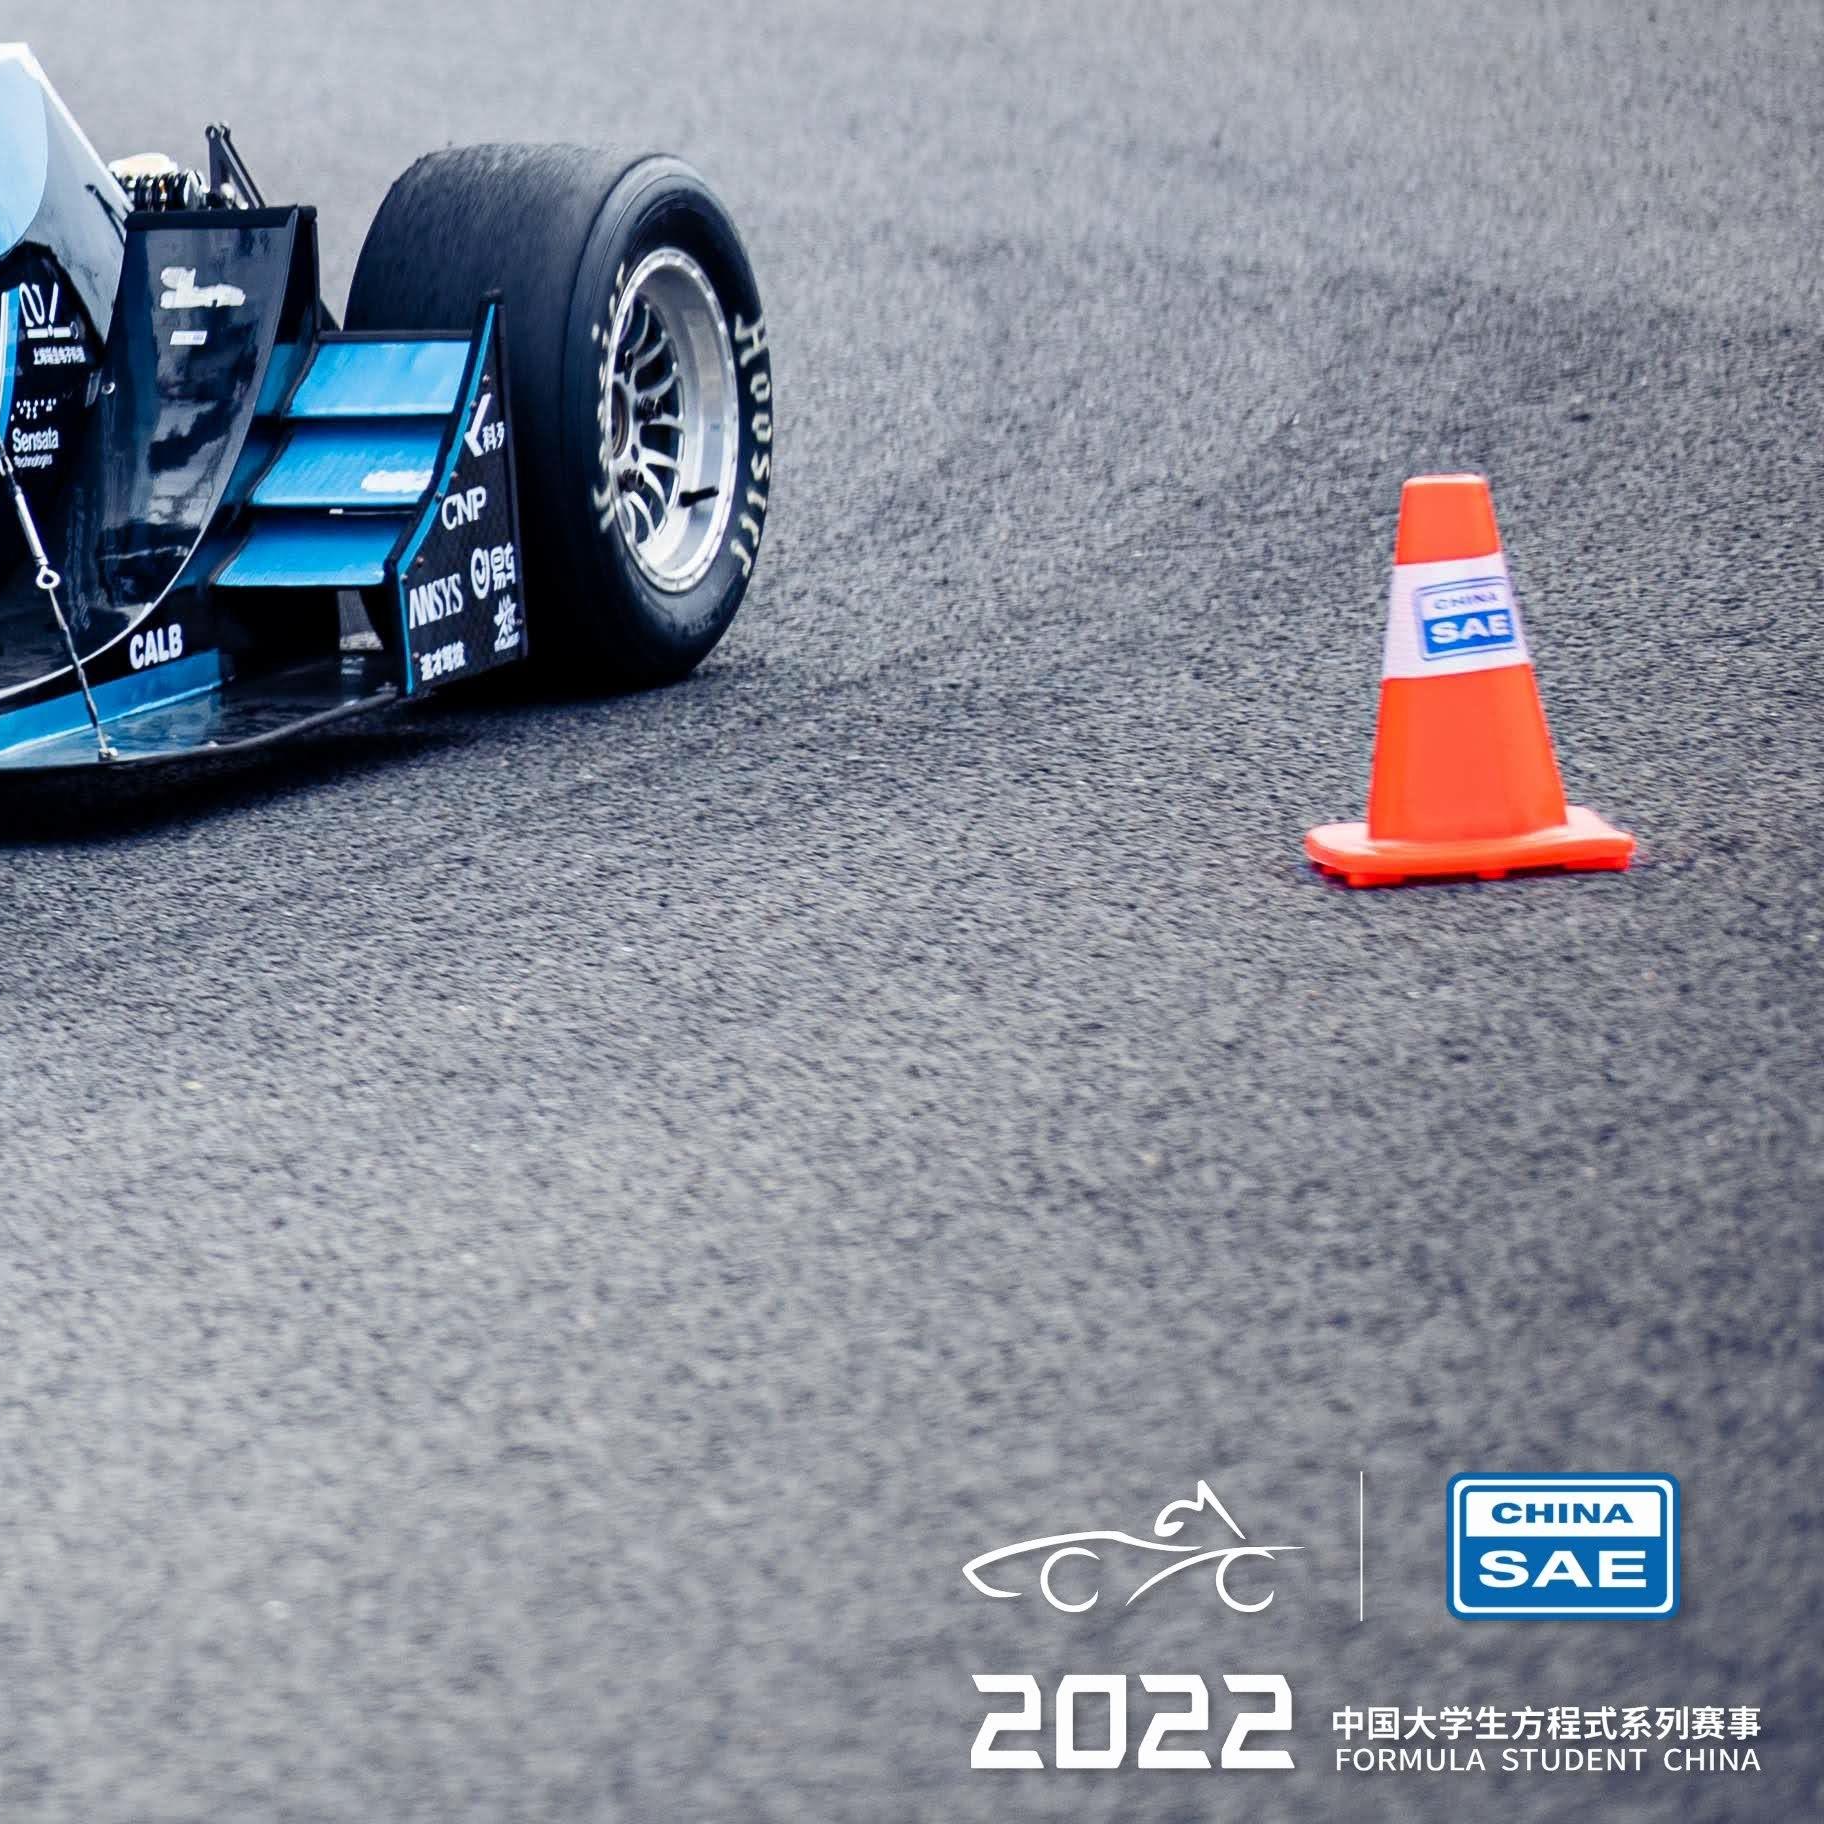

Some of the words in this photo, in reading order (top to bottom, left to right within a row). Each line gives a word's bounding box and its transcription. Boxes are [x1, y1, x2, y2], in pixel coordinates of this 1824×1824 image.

[11, 426, 59, 454] Sensata
[441, 485, 487, 531] CNP
[409, 572, 464, 630] ANSYS
[129, 623, 184, 670] CALB
[1430, 613, 1512, 645] SAE
